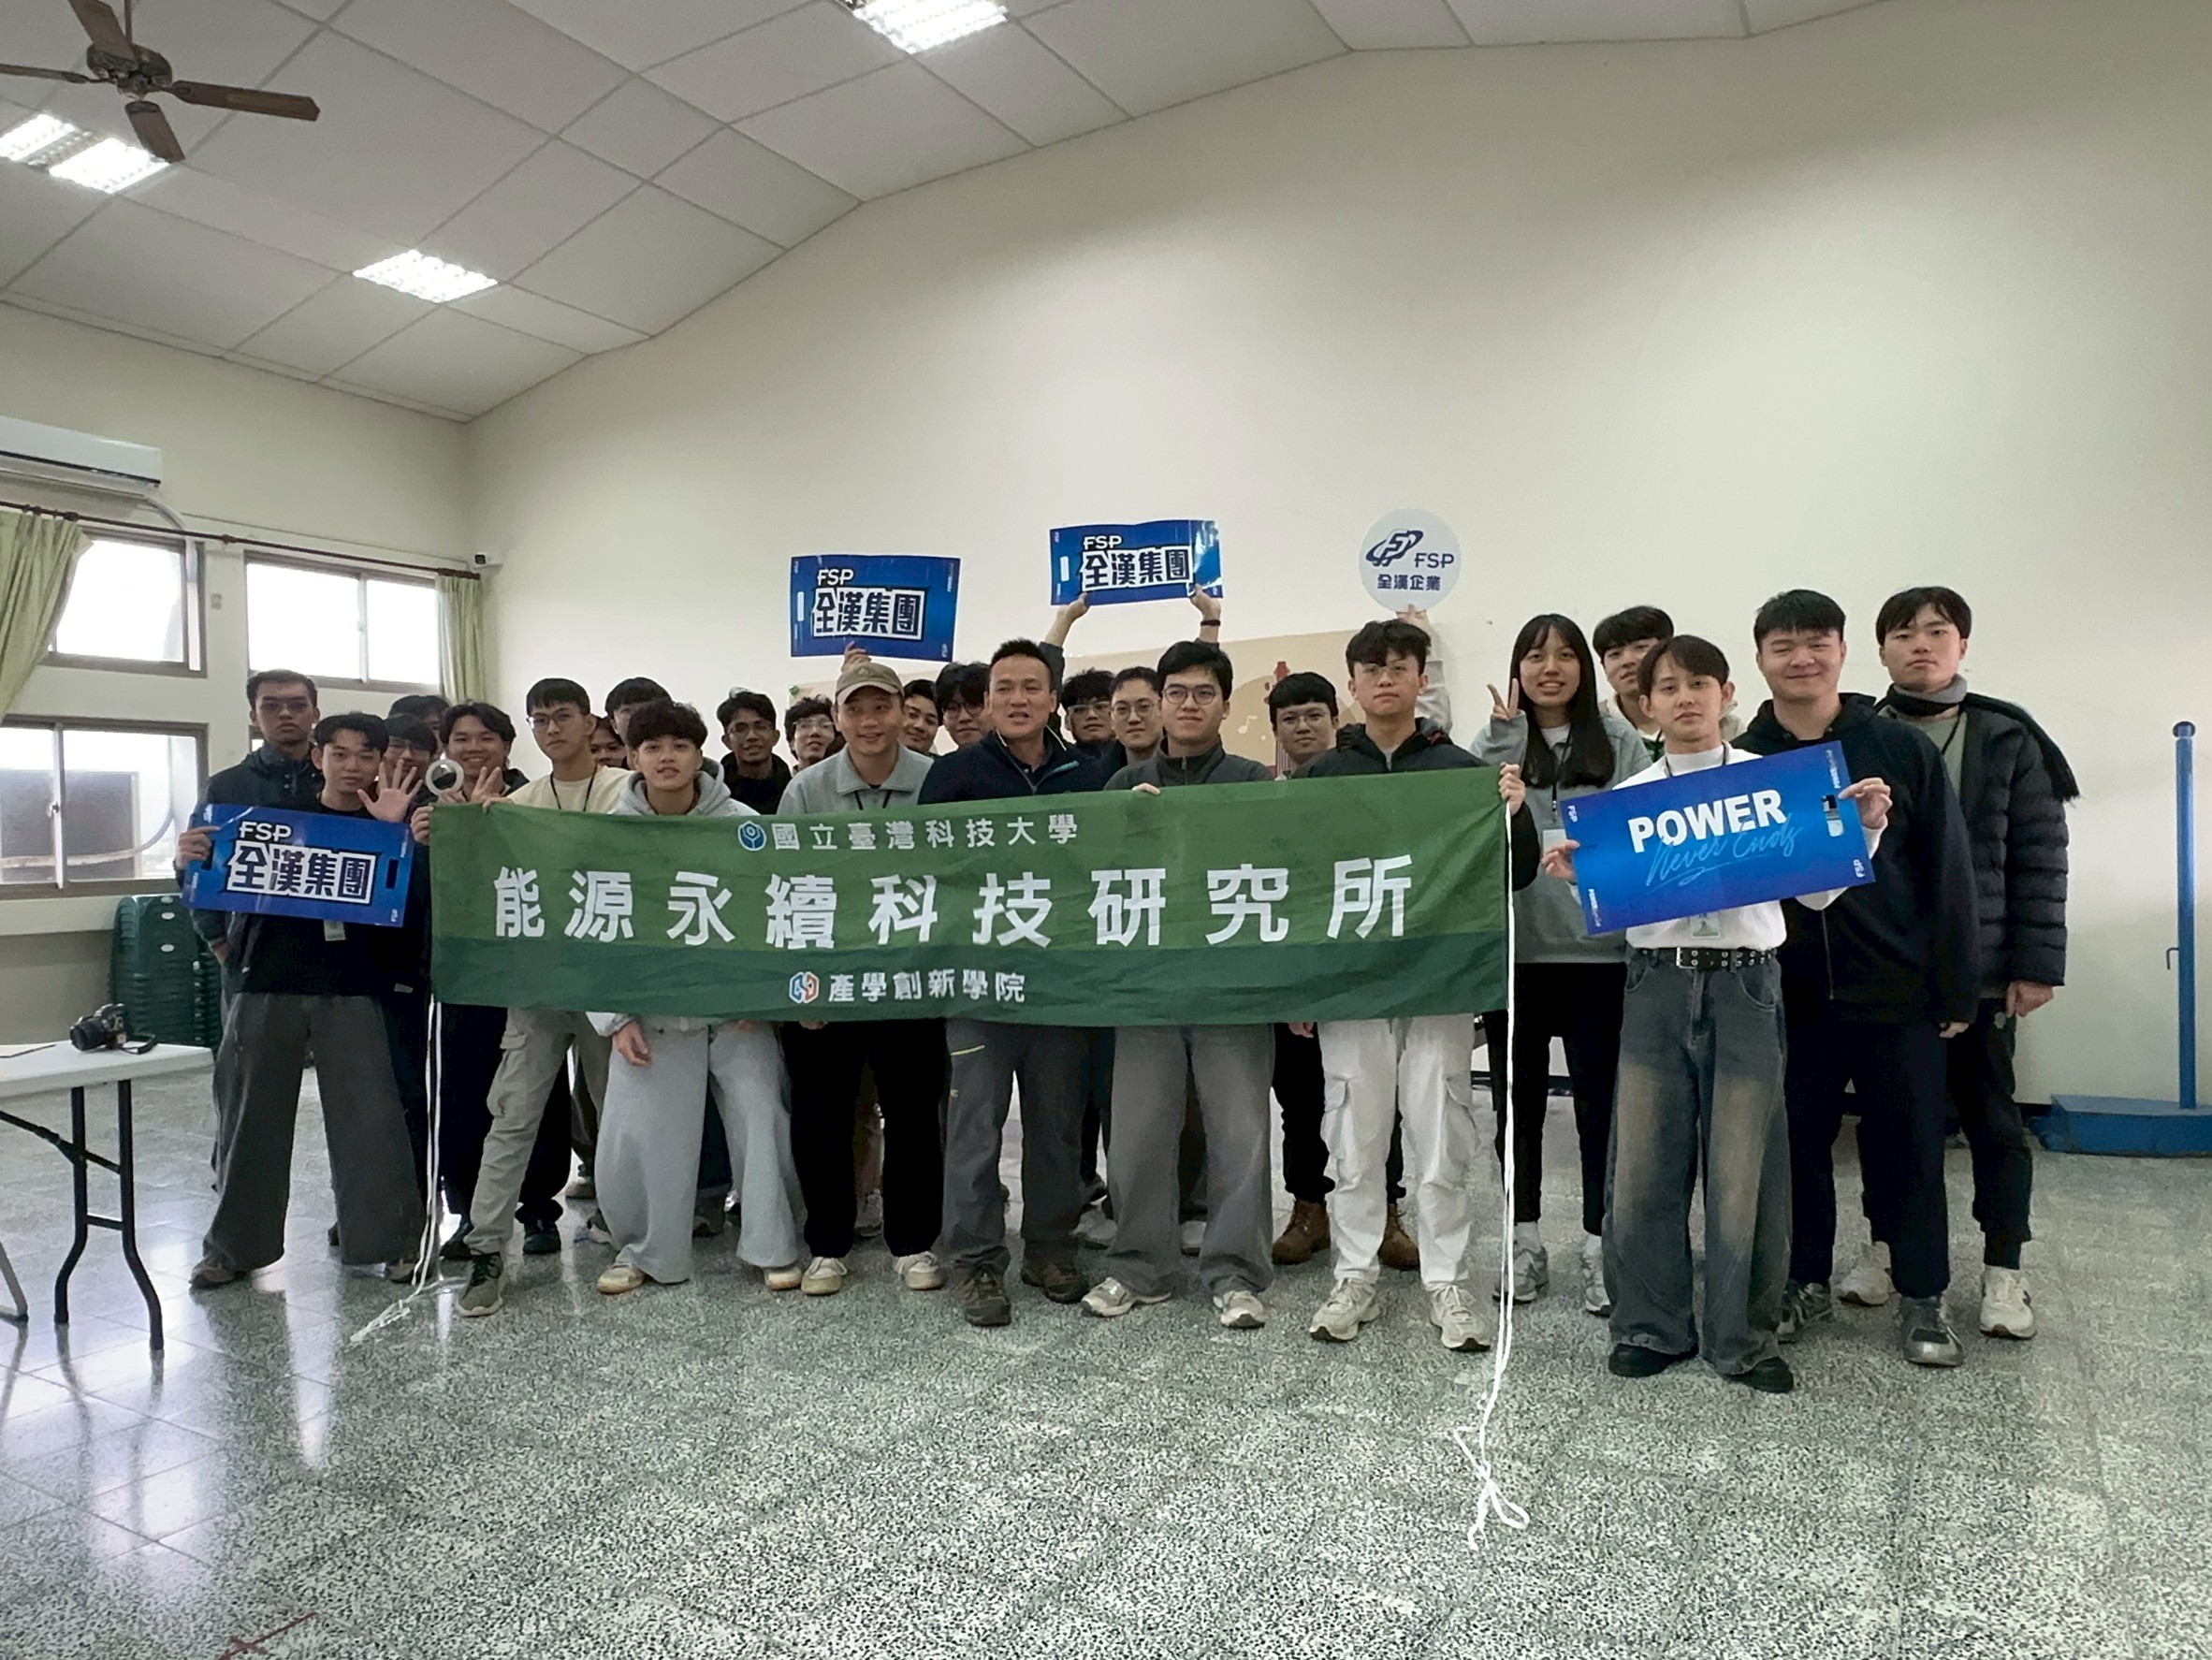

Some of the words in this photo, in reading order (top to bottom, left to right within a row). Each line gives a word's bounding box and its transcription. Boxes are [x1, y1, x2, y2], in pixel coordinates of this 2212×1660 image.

[1084, 535, 1123, 550] FSP
[1414, 552, 1455, 568] FSP
[817, 569, 854, 586] FSP
[1084, 549, 1190, 589] 全漢集團
[1376, 574, 1441, 591] 全漢企業
[815, 591, 922, 636] 全漢集團
[239, 821, 293, 842] FSP
[771, 813, 1078, 851] 國立臺灣科技大學
[1627, 789, 1787, 853] POWER
[230, 844, 373, 902] 全漢集團
[492, 854, 1413, 950] 能源永續科技研究所
[828, 968, 1026, 1003] 產學創新學院
